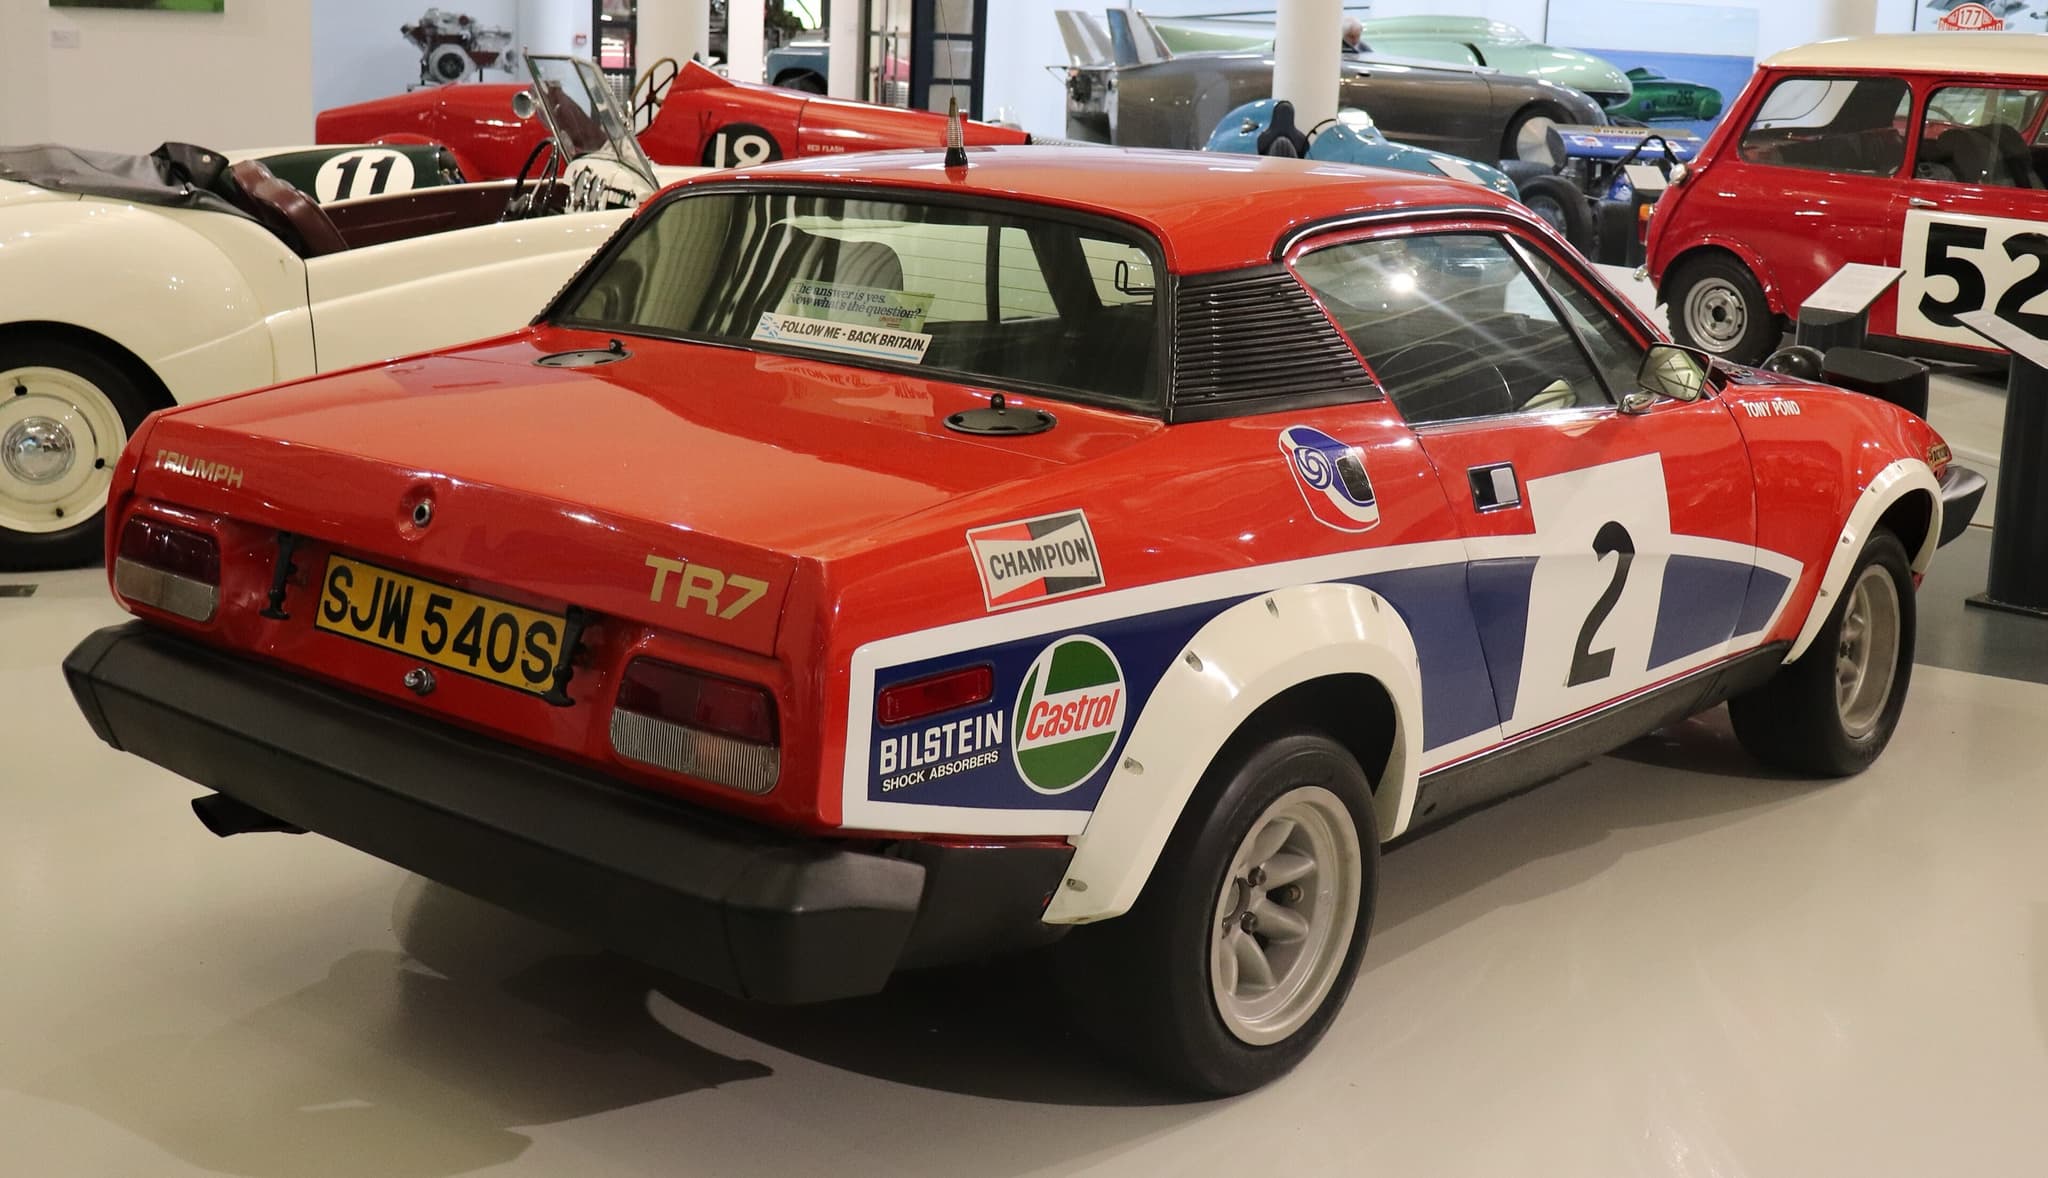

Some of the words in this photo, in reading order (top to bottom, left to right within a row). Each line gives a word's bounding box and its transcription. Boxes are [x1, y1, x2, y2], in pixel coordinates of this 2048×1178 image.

[1960, 9, 1981, 25] 177
[714, 133, 771, 168] 18
[806, 144, 821, 152] RED
[822, 144, 845, 153] FLASH
[333, 155, 397, 201] 11
[793, 282, 813, 295] The
[813, 286, 855, 300] answer
[854, 289, 865, 301] is
[1918, 221, 2048, 341] 52
[790, 292, 813, 306] Now
[813, 296, 847, 311] what's
[847, 300, 866, 313] the
[866, 303, 922, 320] question?
[780, 319, 826, 337] FOLLOW
[824, 326, 842, 340] ME
[847, 329, 882, 345] BACK
[879, 334, 925, 351] BRITAIN.
[1742, 400, 1771, 418] TONY
[1771, 399, 1801, 417] POND
[155, 448, 244, 489] TRIUMPH
[989, 537, 1090, 581] CHAMPION
[644, 553, 771, 621] TR7
[1566, 520, 1636, 688] 2
[323, 564, 415, 645] SJW
[420, 593, 558, 684] 540S
[1025, 688, 1121, 742] Castrol
[879, 709, 1004, 776] BILSTEIN
[882, 768, 926, 793] SHOCK
[929, 750, 999, 780] ABSORBERS
